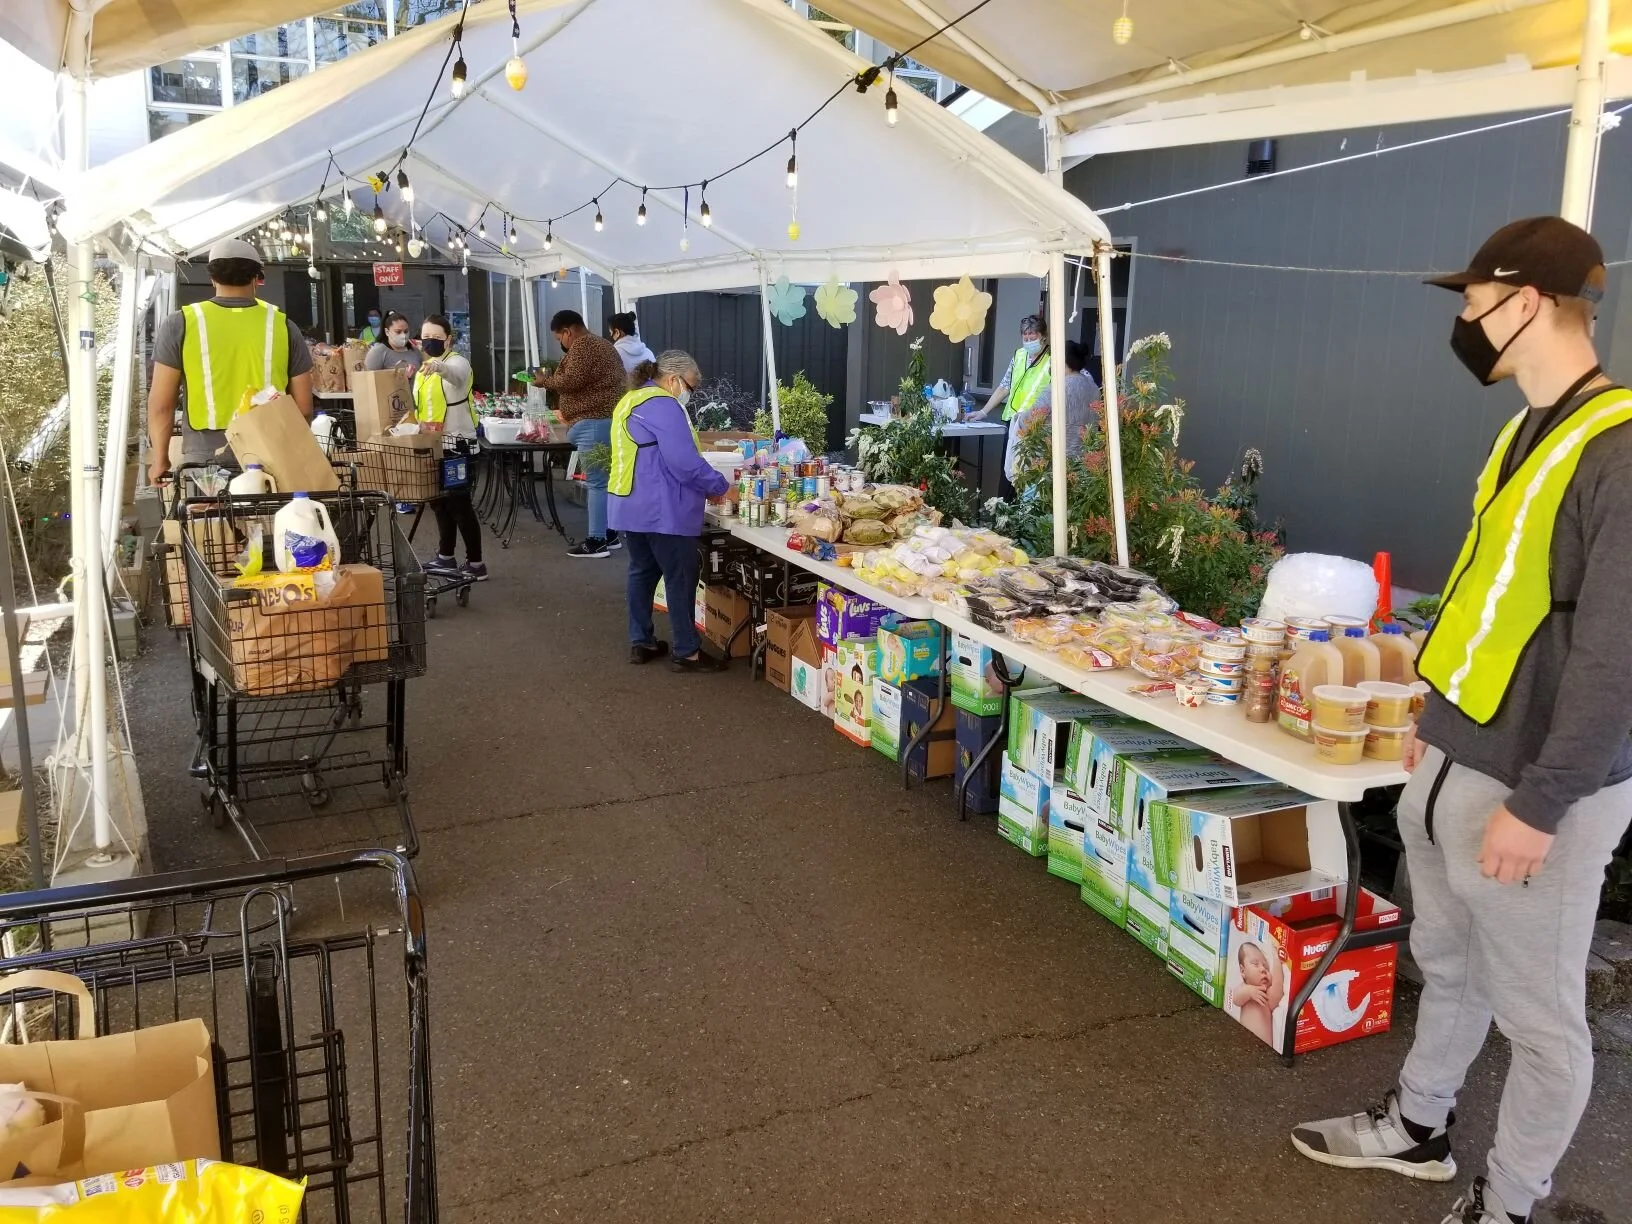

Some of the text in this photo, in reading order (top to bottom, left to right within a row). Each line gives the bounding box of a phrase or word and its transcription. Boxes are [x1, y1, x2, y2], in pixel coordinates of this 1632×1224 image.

[376, 265, 399, 273] STAFF
[379, 274, 400, 283] ONLY
[240, 585, 280, 607] ONEY
[849, 602, 871, 617] Luvs
[820, 605, 830, 639] Luvs
[766, 639, 787, 658] HUGGIES
[1009, 769, 1036, 791] BabyWipes
[1096, 762, 1107, 810] BabyWipes
[1038, 844, 1047, 853] 90
[1095, 830, 1126, 854] BabyWipes
[1209, 839, 1222, 899] BabyWipes
[1223, 846, 1232, 877] KIRKLAND
[1182, 893, 1219, 924] BabyWipes
[1302, 943, 1330, 957] HUGG
